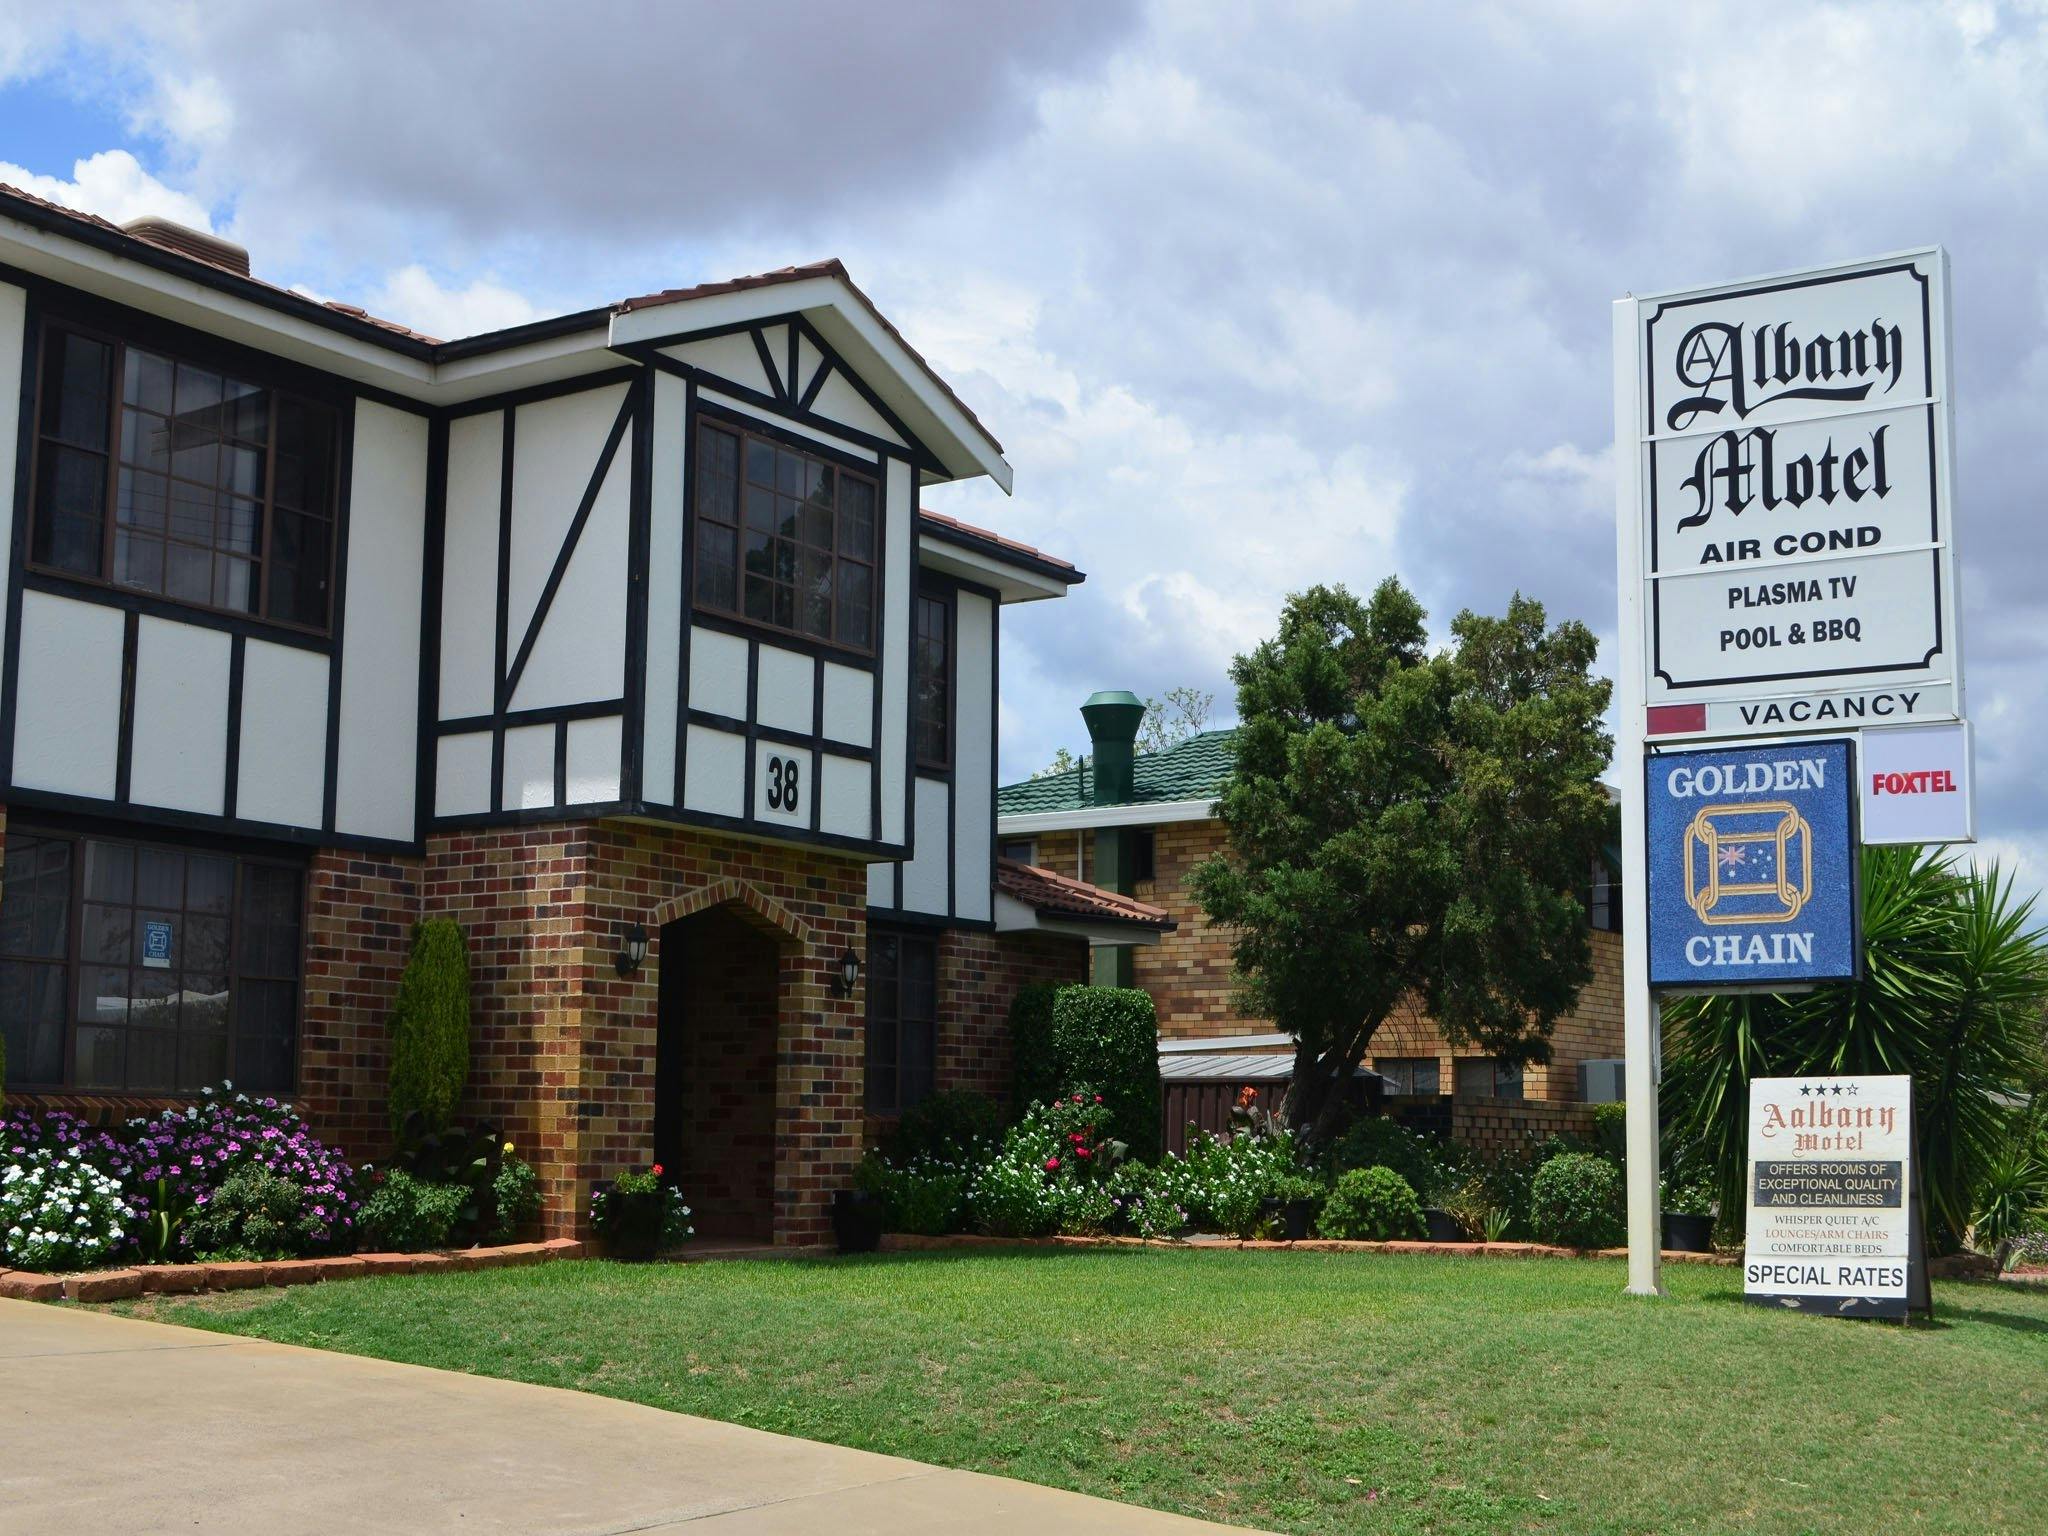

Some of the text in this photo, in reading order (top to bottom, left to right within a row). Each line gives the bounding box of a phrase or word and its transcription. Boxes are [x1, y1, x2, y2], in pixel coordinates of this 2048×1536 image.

[1677, 424, 1892, 532] Motel
[1700, 526, 1881, 564] AIR COND
[1728, 576, 1857, 609] PLASMA TV
[1720, 617, 1861, 652] POOL & BBQ
[1740, 692, 1920, 725] VACANCY
[768, 756, 798, 812] 38
[1667, 758, 1827, 797] GOLDEN
[1872, 770, 1957, 795] FOXTEL
[1685, 932, 1814, 966] CHAIN
[1762, 1100, 1896, 1137] Aalbany
[1792, 1131, 1864, 1158] Motel
[1759, 1178, 1897, 1190] EXCEPTIONAL QUALITY
[1769, 1164, 1887, 1175] OFFERS ROOMS OF
[1771, 1193, 1883, 1205] AND CLEANLINESS
[1765, 1229, 1889, 1240] LOUNGES/ARM CHAIRS
[1775, 1215, 1880, 1227] WHISPER QUIET A/C
[1771, 1243, 1882, 1254] COMFORTABLE BEDS
[1747, 1264, 1903, 1287] SPECIAL RATES
